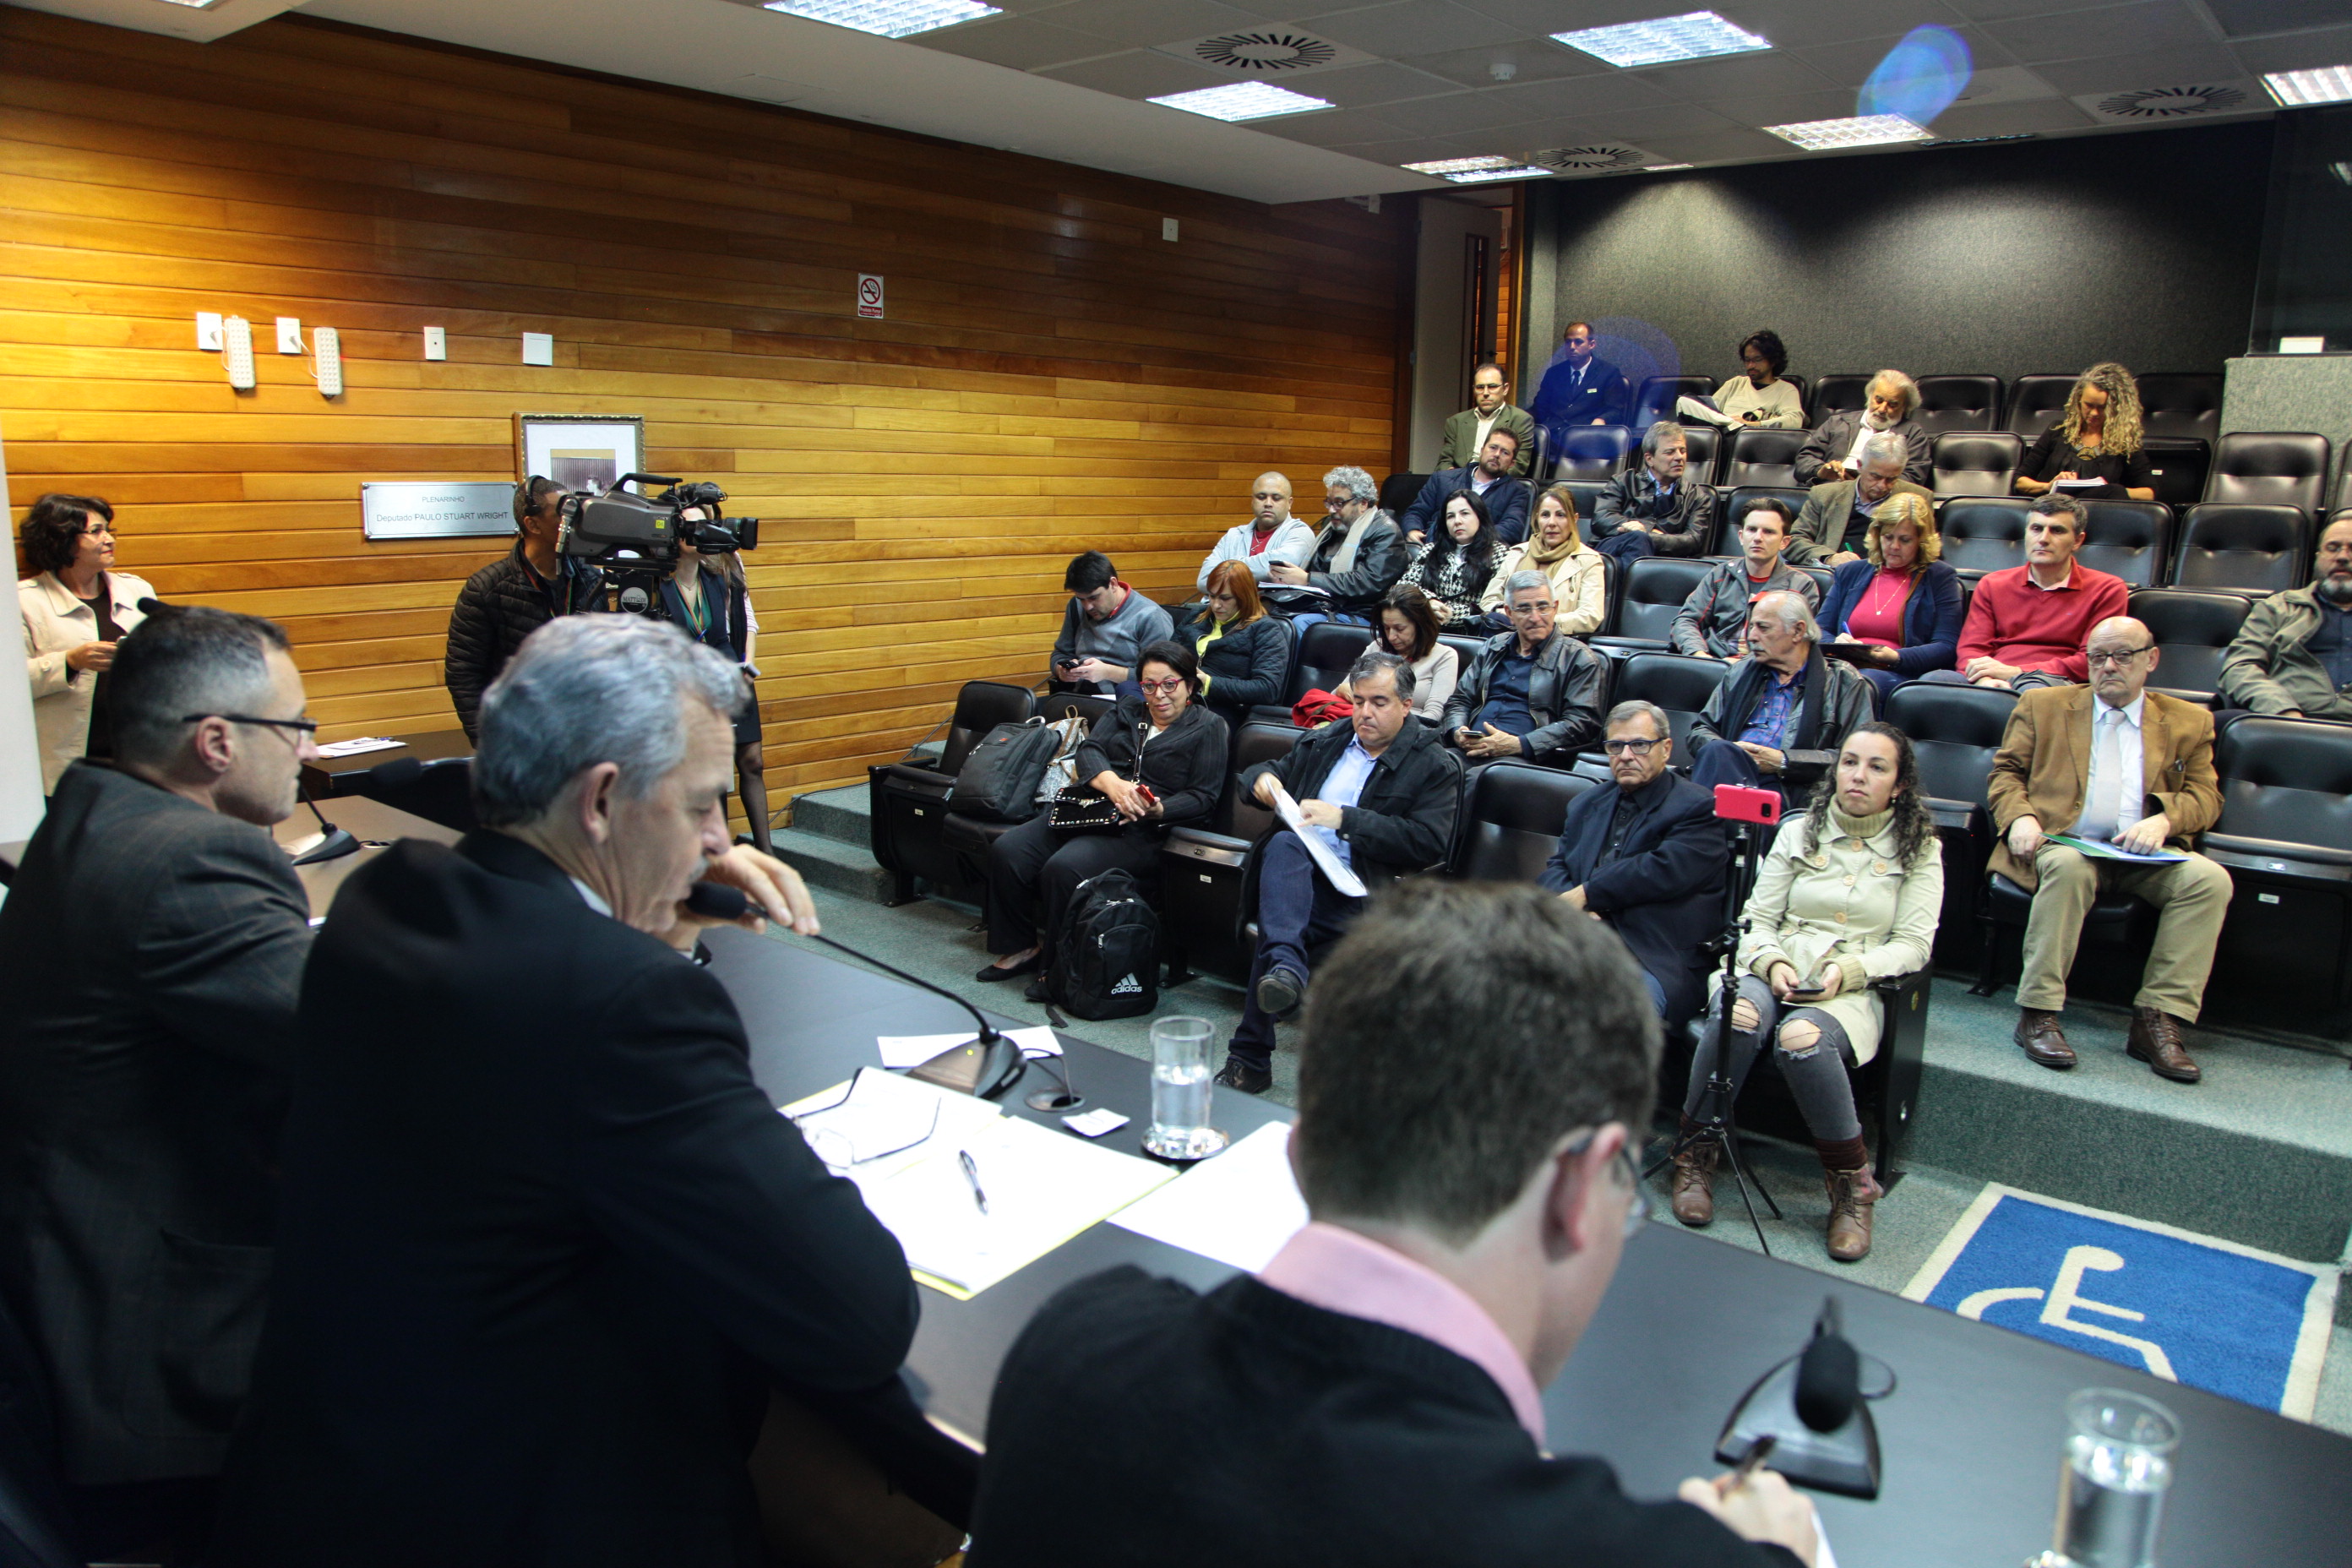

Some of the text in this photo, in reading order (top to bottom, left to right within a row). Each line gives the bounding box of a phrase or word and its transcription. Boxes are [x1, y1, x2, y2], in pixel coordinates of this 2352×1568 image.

[376, 514, 412, 522] Deputado
[444, 512, 476, 520] STUART
[477, 511, 509, 520] WRIGHT
[1111, 984, 1142, 994] adidas
